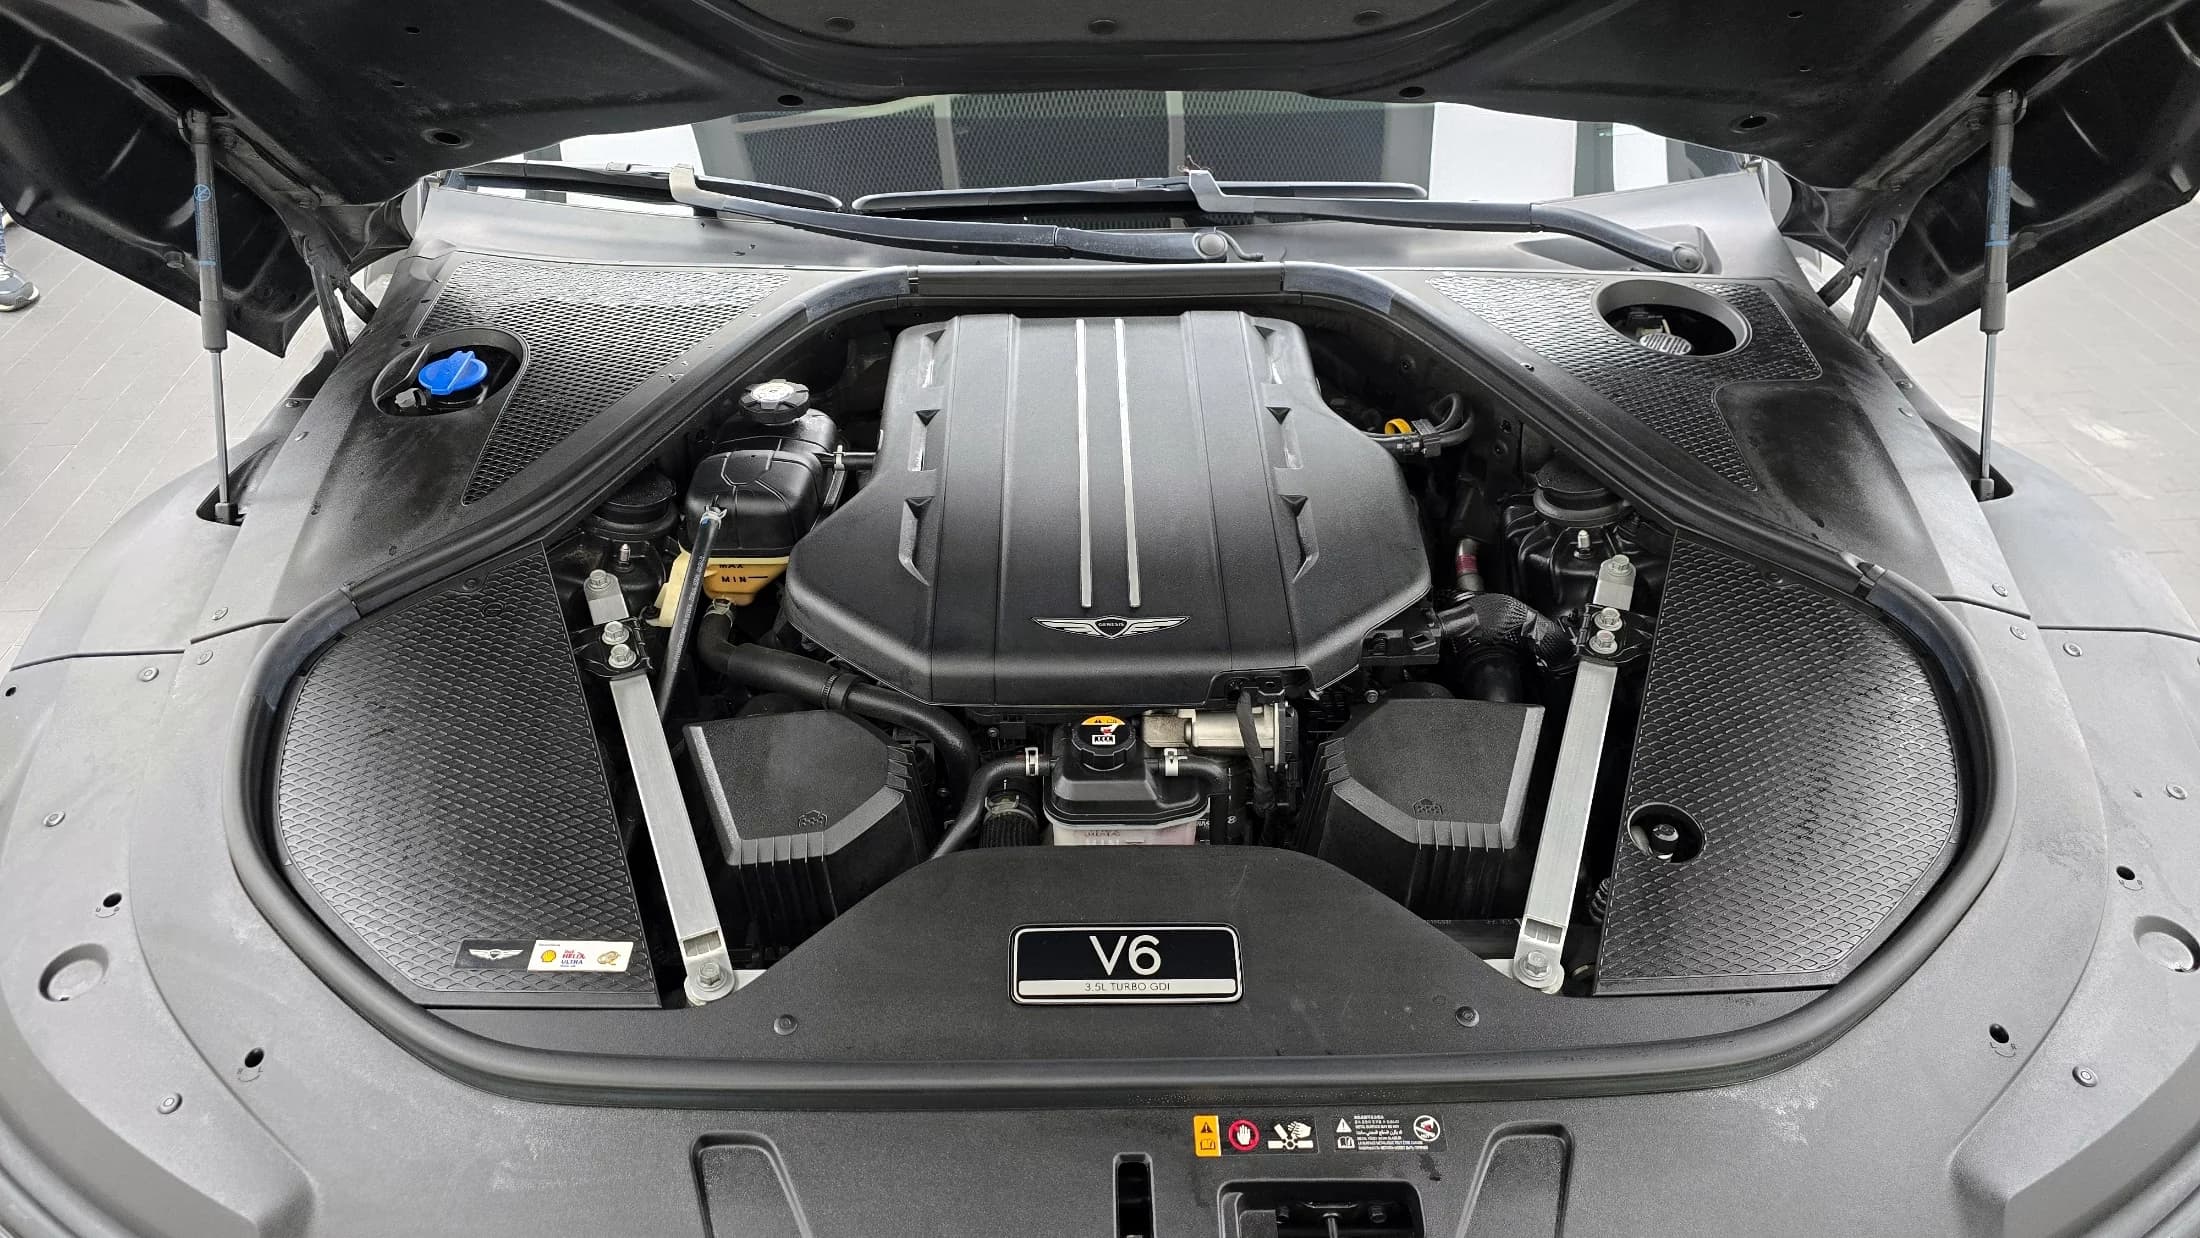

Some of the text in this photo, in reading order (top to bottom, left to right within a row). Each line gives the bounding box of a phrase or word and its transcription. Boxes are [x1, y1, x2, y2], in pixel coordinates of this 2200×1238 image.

[1089, 934, 1162, 976] V6
[1084, 982, 1170, 992] 3.5L TURBO GDI
